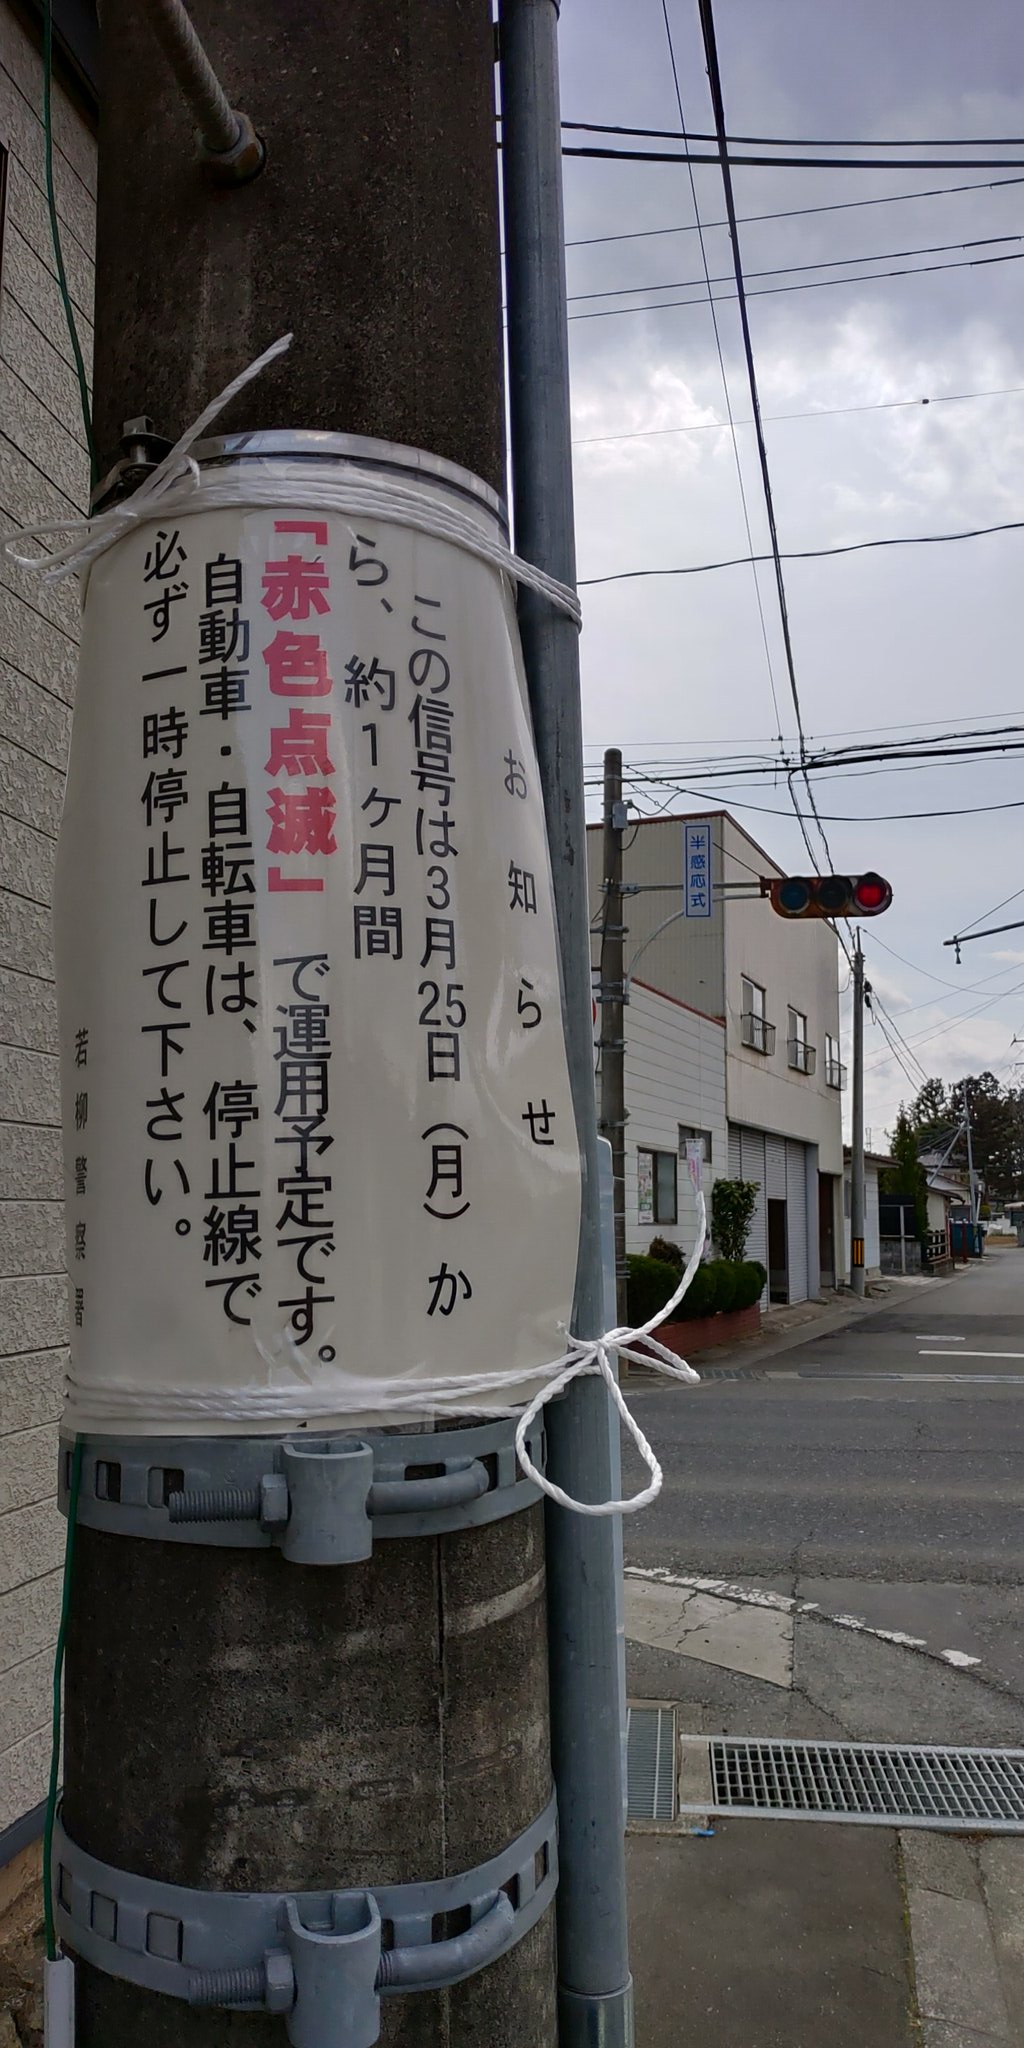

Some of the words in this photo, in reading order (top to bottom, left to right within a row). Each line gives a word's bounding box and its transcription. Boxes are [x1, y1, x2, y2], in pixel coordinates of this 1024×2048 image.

[141, 529, 192, 1237] 必ず一時停止して下さい。
[198, 552, 263, 1327] 自動車・自転車は、停止線で
[503, 748, 557, 1146] お知らせ
[690, 834, 706, 908] 半感応式
[74, 1027, 89, 1328] 若柳警察署
